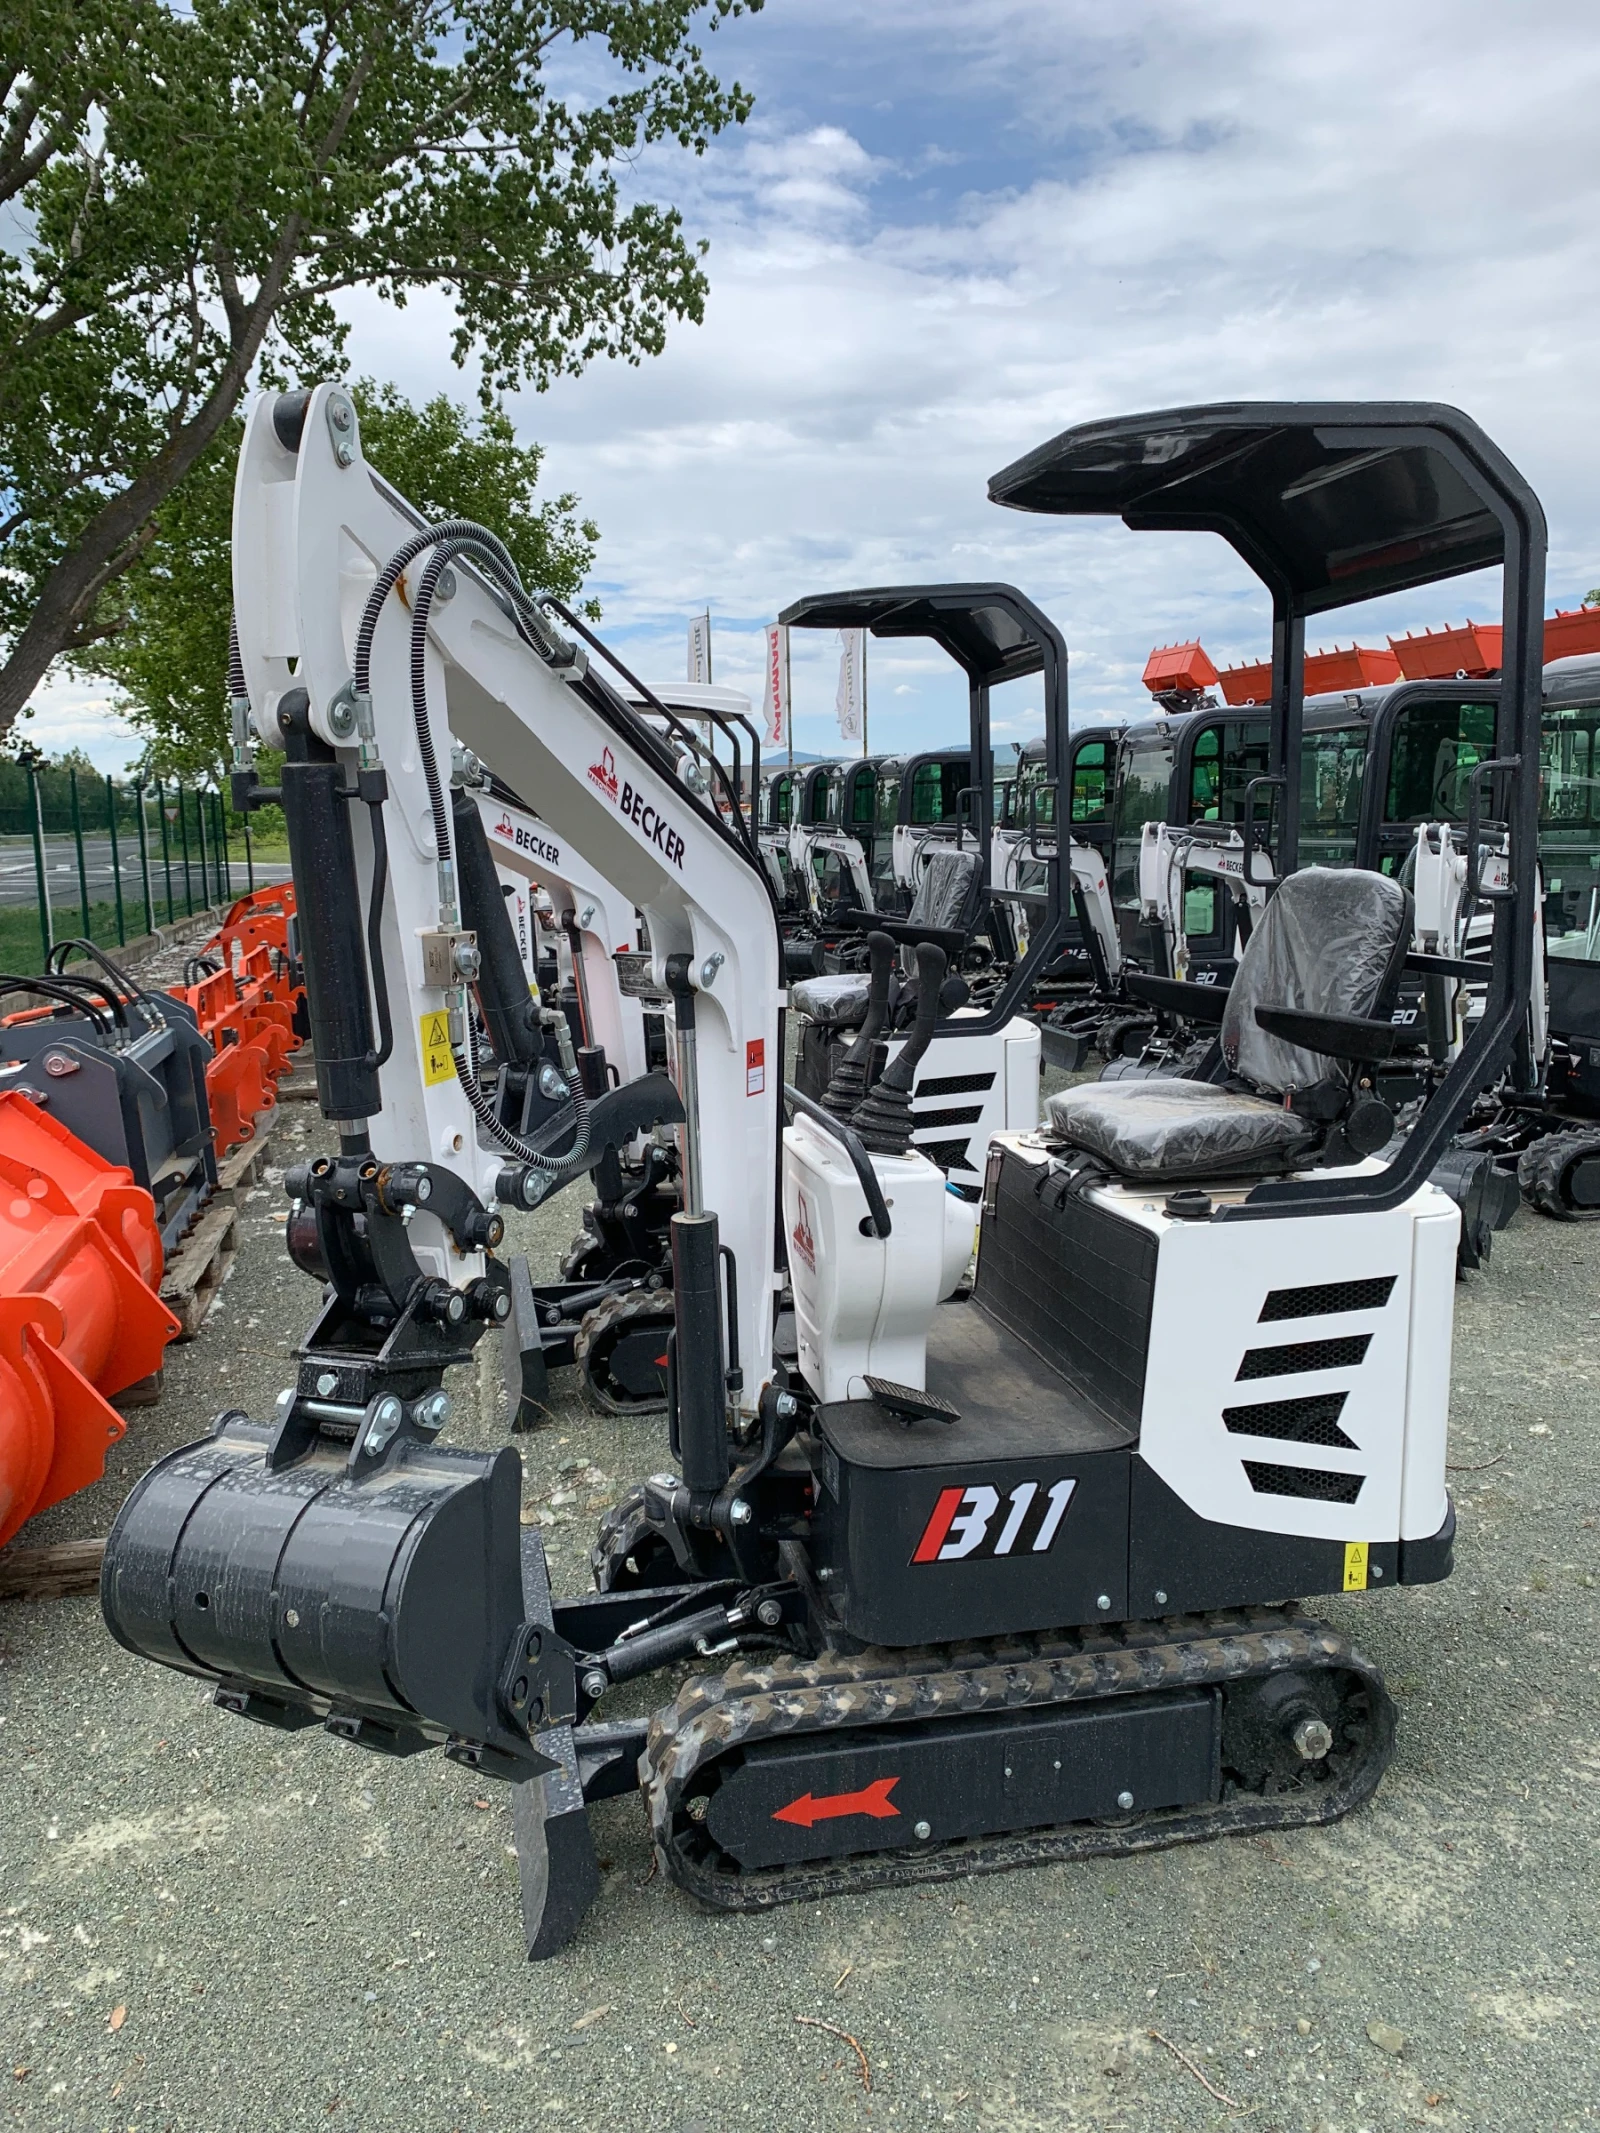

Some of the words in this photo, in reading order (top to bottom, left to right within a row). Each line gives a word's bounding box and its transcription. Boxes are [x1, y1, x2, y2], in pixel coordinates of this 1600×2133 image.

[587, 770, 618, 804] MASCHINEN
[620, 781, 686, 871] BECKER
[515, 827, 560, 866] BECKER
[1226, 859, 1244, 874] BECKE
[518, 915, 528, 961] BECKER
[1195, 972, 1218, 985] 20
[1391, 1009, 1418, 1025] 20
[912, 1479, 1077, 1563] B11
